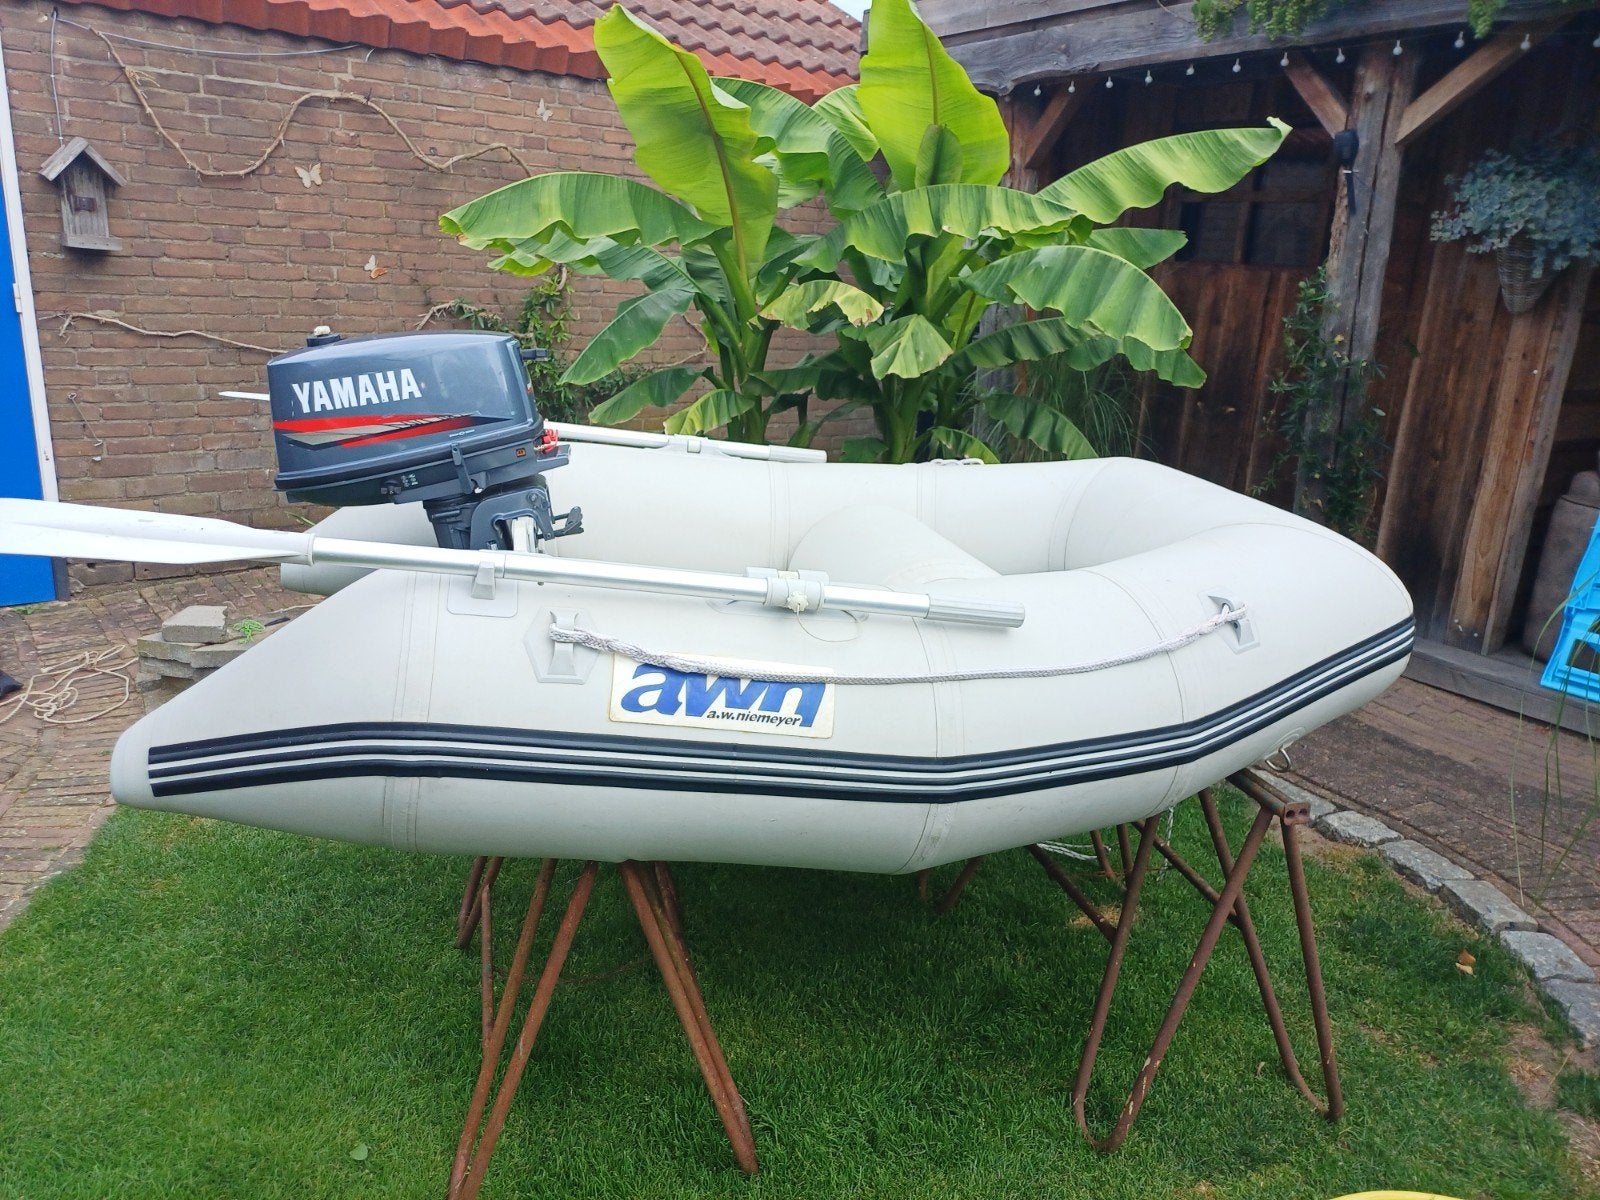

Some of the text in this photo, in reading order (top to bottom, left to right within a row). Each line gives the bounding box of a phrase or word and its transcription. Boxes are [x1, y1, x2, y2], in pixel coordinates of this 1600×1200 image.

[291, 368, 422, 414] YAMAHA
[620, 662, 827, 728] awn
[706, 708, 801, 728] a.w.niemeyer
